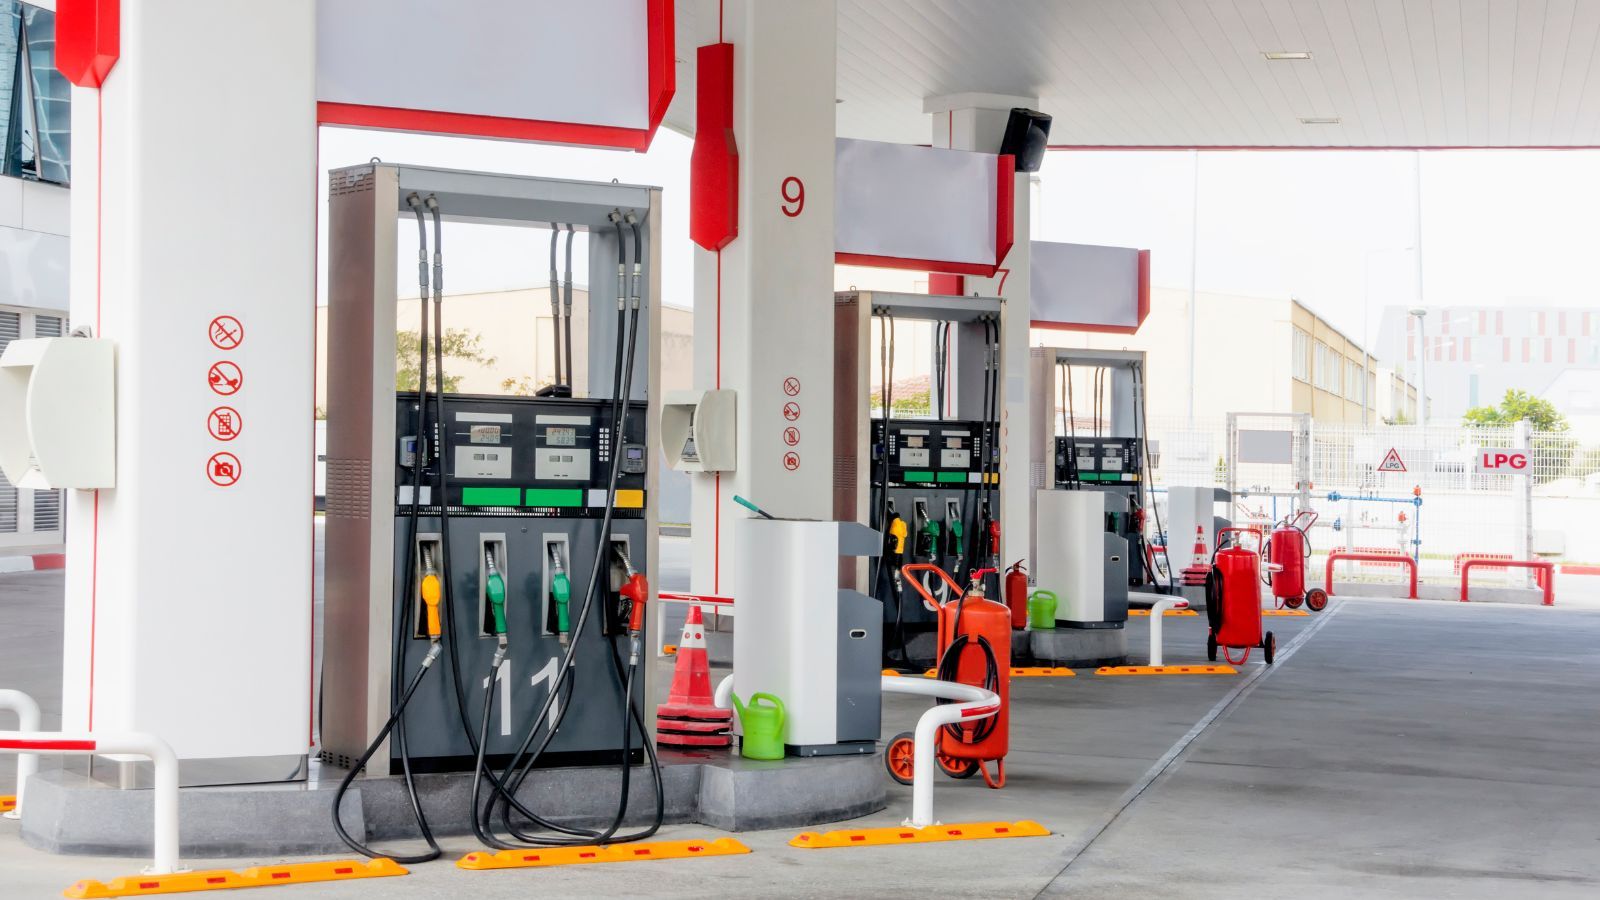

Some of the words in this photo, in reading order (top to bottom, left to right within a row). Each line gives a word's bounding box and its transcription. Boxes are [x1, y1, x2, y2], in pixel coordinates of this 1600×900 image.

[781, 176, 805, 218] 9
[996, 268, 1010, 296] 7
[1483, 453, 1527, 470] LPG
[922, 569, 949, 612] 9
[483, 656, 559, 736] 11
